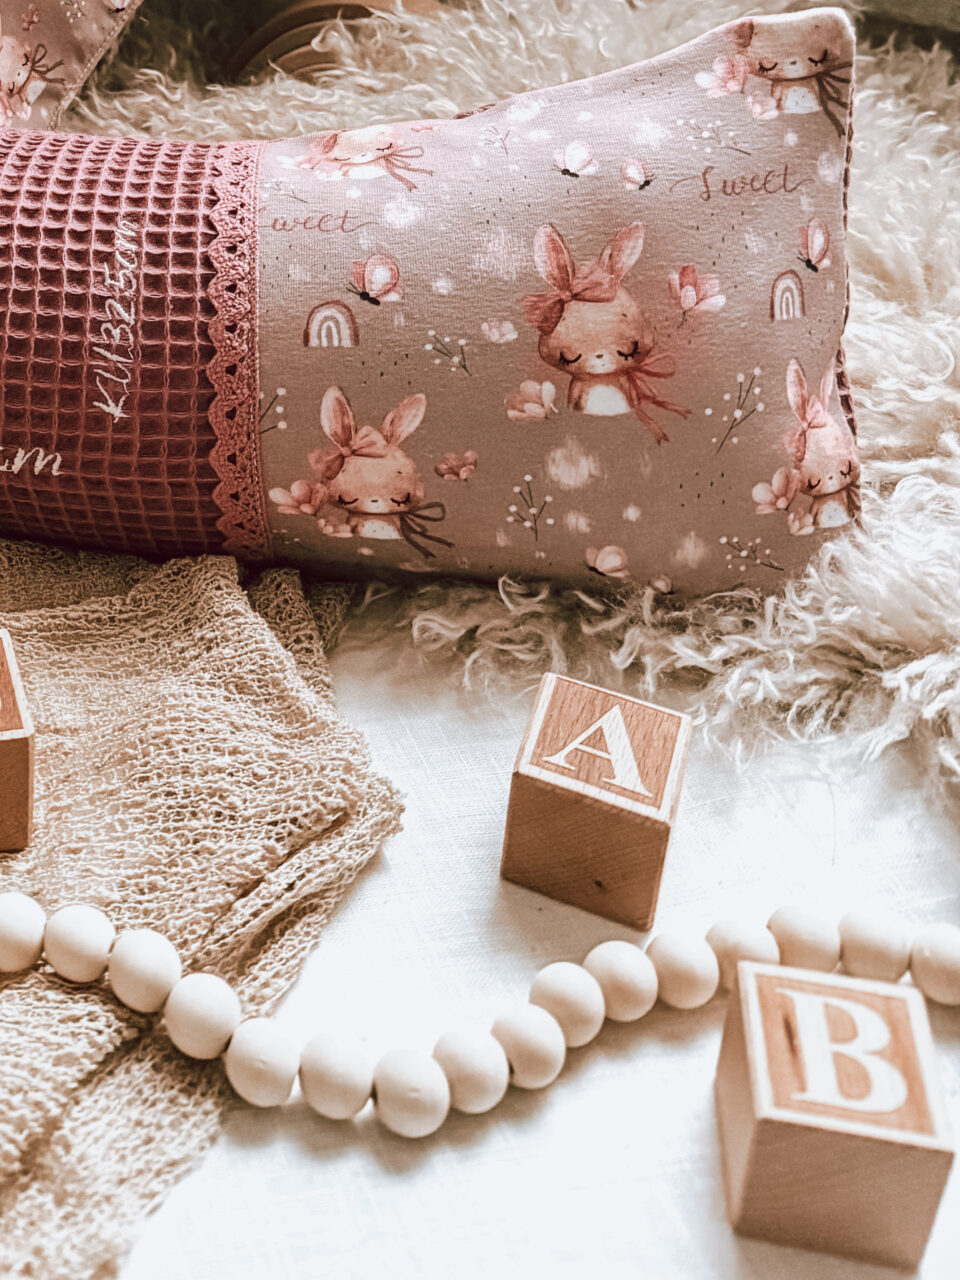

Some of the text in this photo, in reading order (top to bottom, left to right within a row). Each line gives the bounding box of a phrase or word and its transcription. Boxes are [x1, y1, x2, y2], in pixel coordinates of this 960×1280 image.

[257, 207, 379, 233] weet
[541, 704, 654, 798] A
[774, 987, 908, 1113] B
